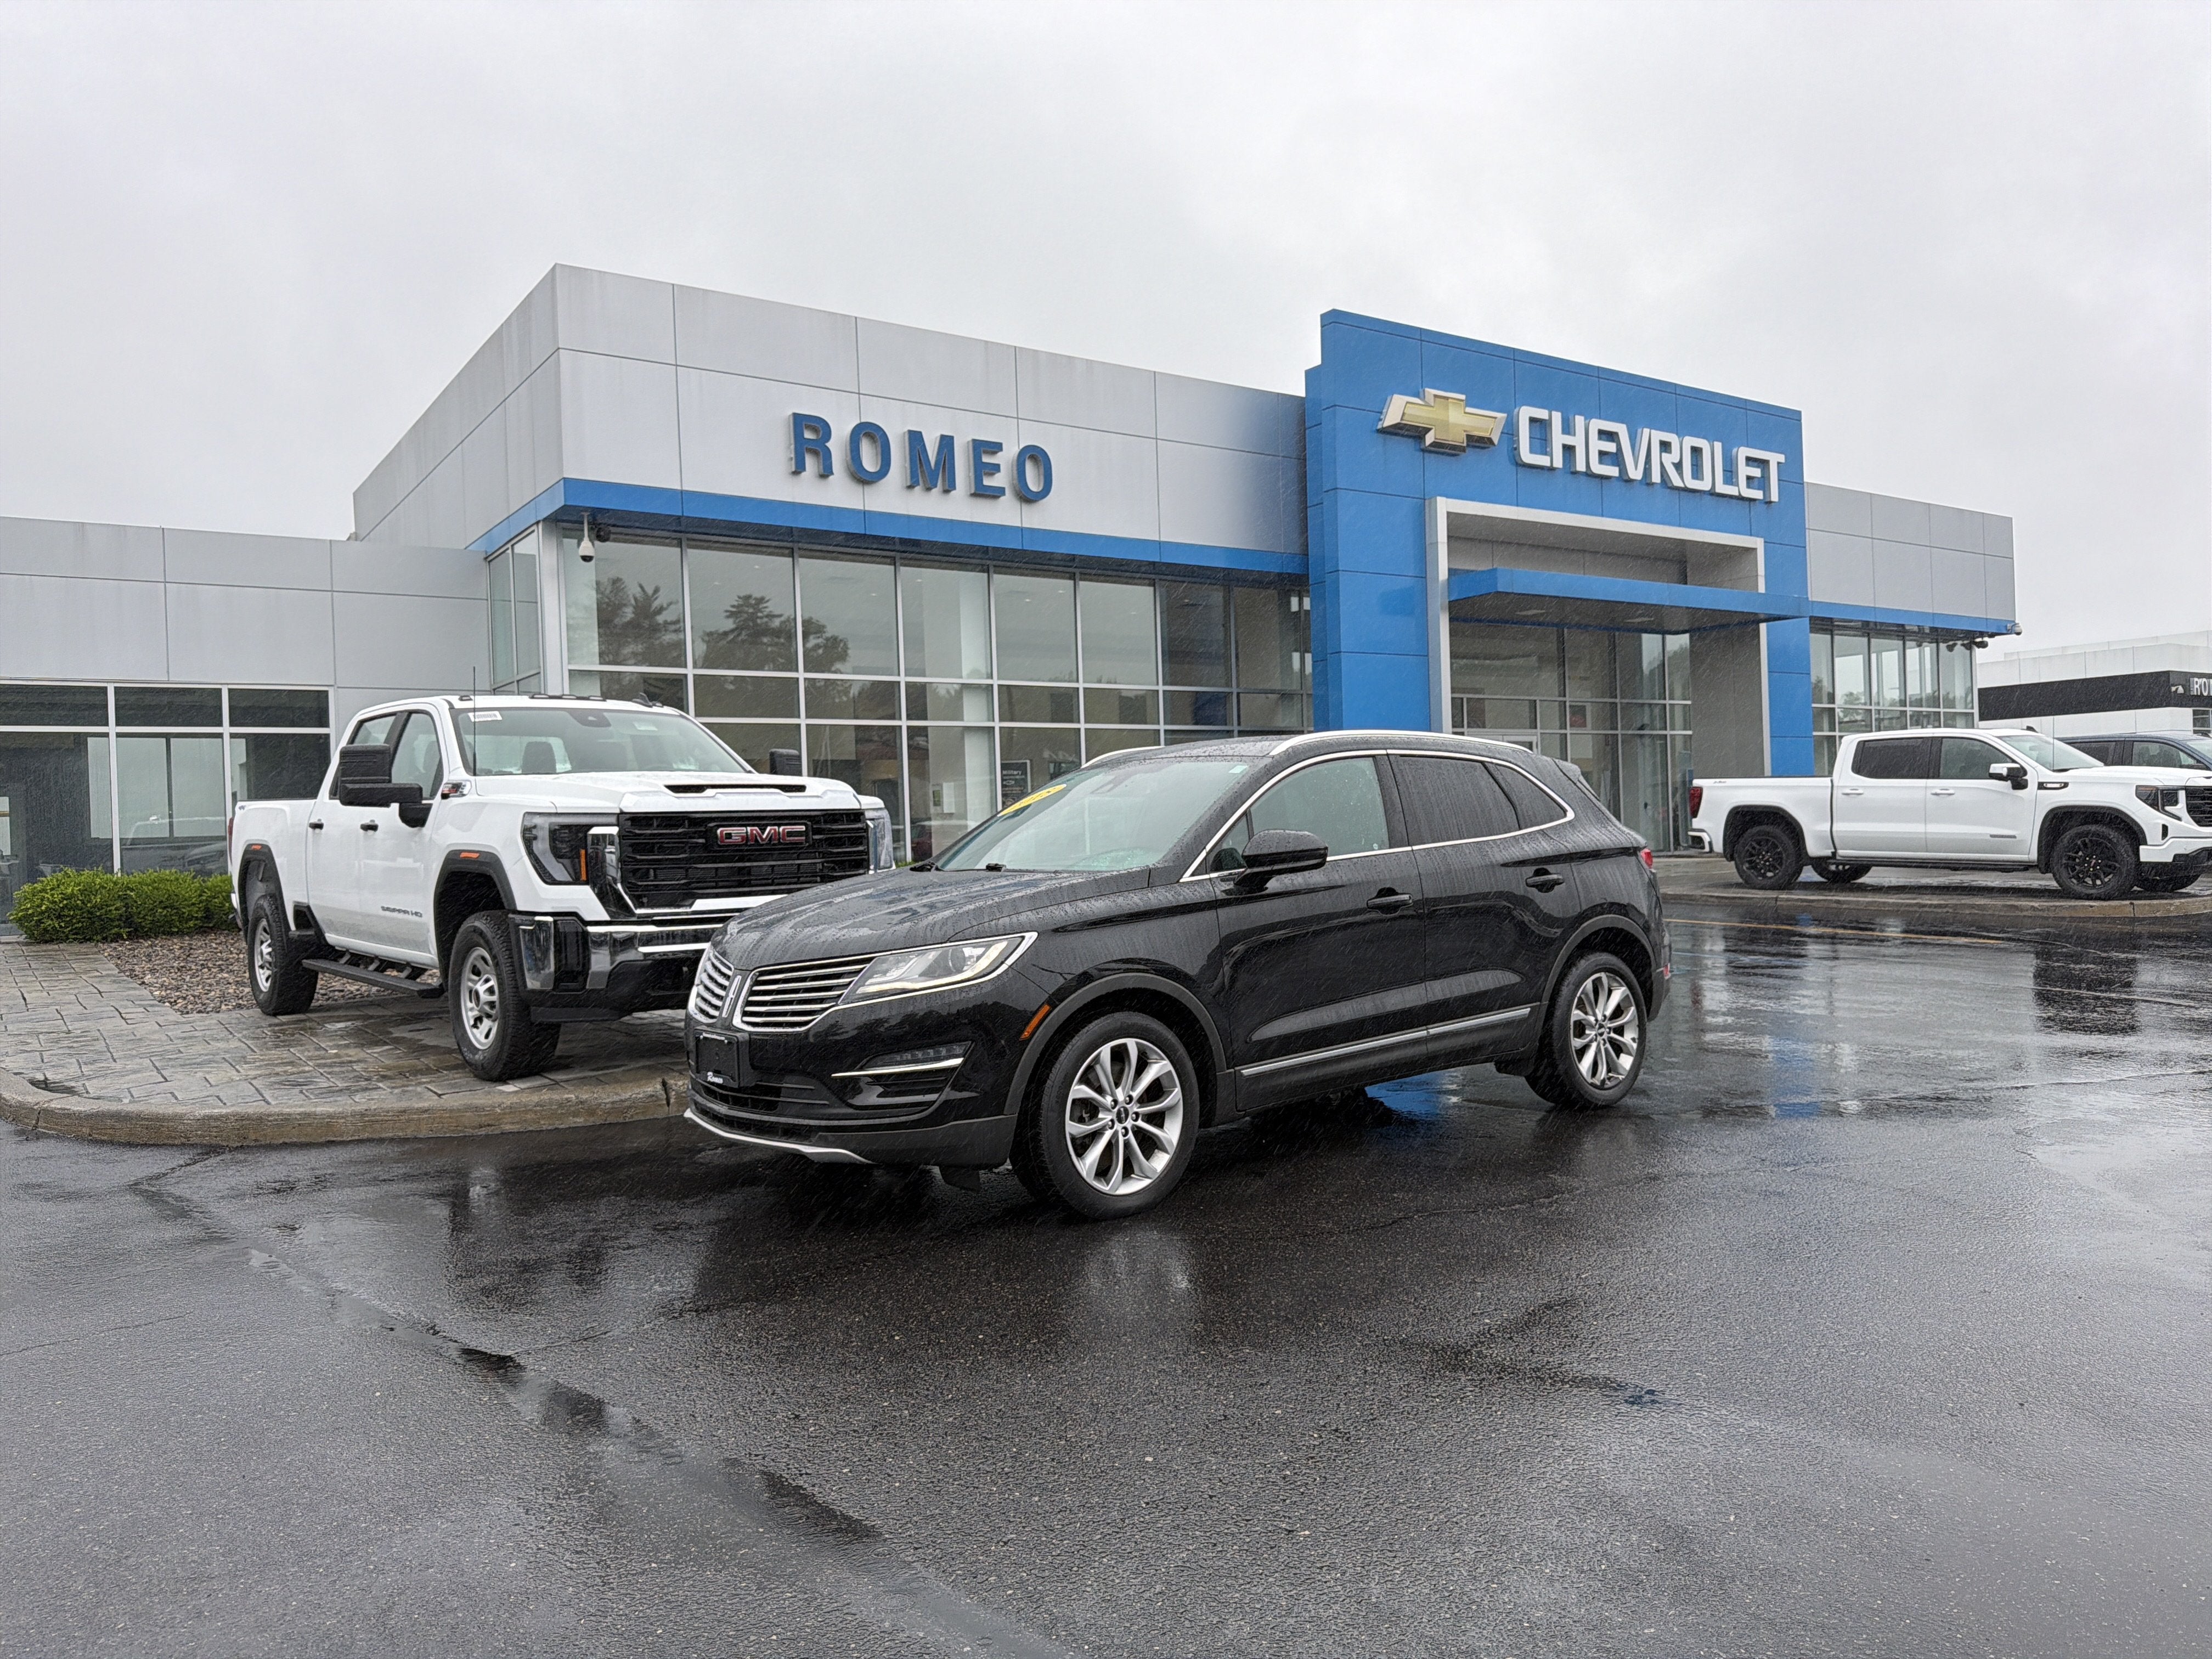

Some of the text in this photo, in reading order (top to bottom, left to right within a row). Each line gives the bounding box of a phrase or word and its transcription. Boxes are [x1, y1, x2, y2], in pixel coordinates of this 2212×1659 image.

[789, 412, 1053, 502] ROMEO
[1514, 405, 1785, 503] CHEVROLET
[2191, 678, 2212, 696] RO
[717, 825, 806, 845] GMC
